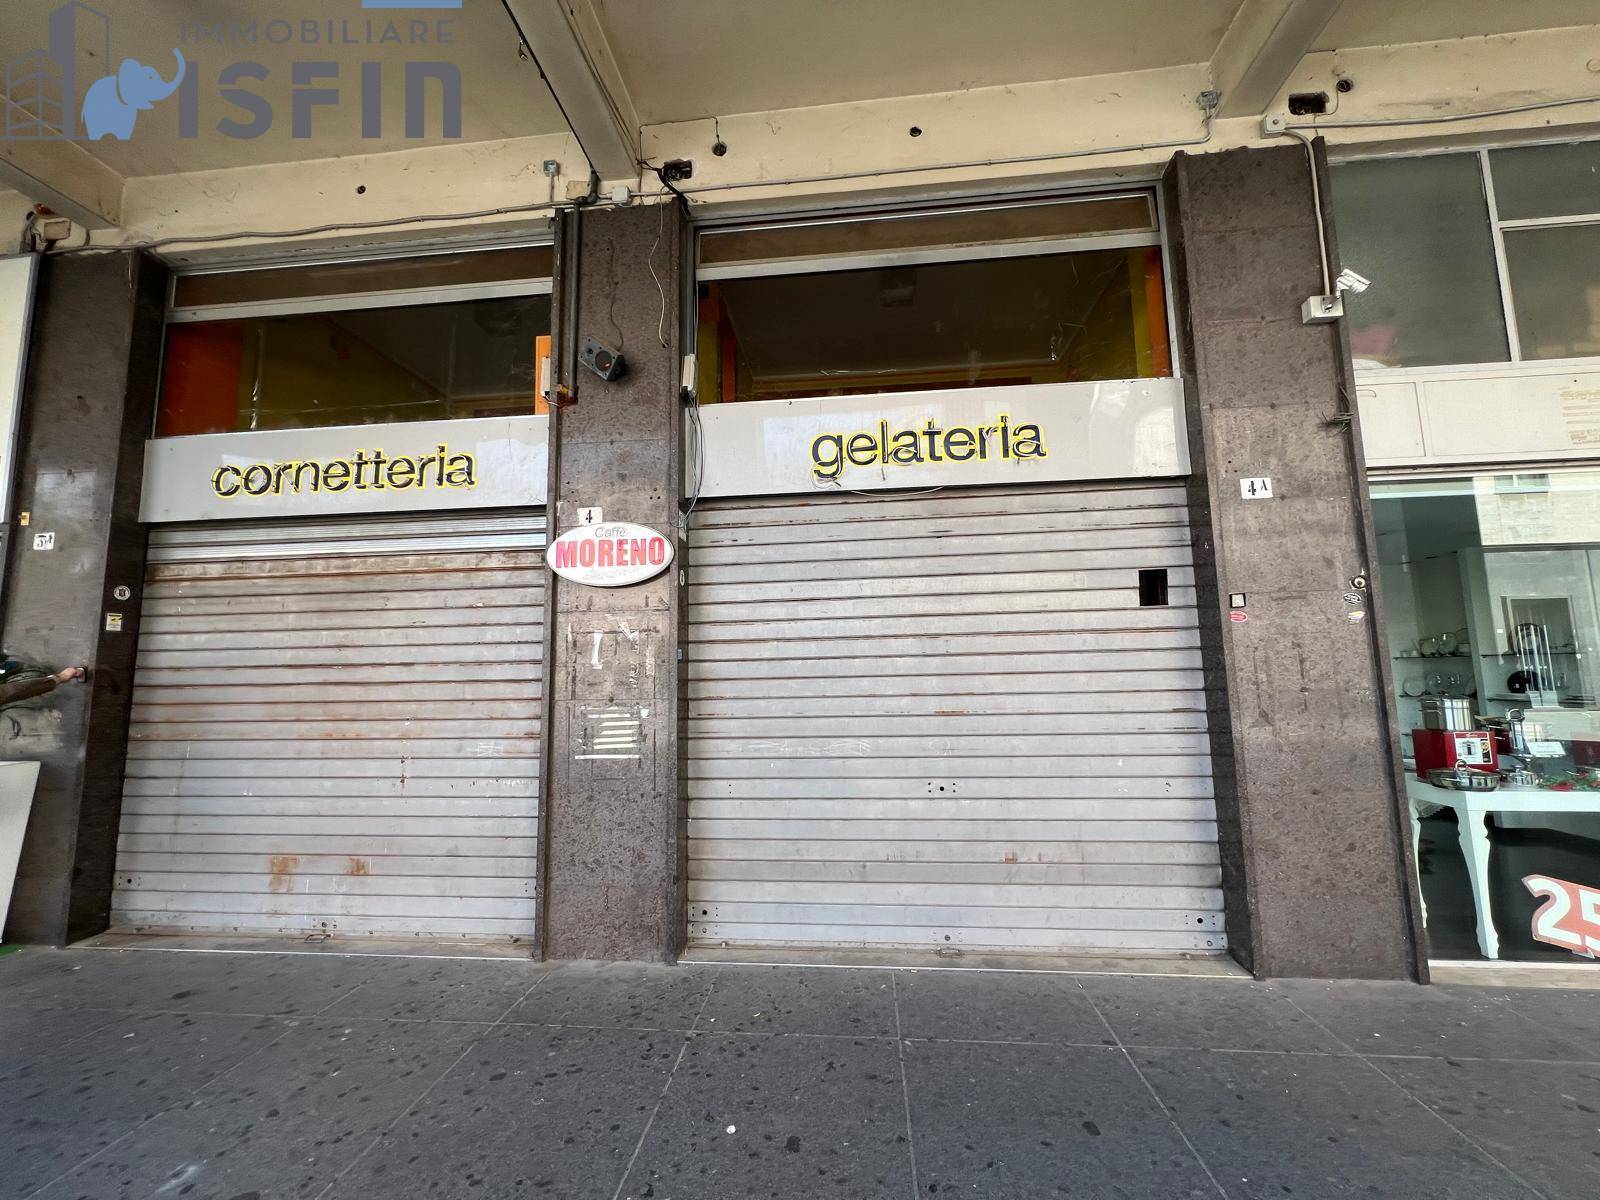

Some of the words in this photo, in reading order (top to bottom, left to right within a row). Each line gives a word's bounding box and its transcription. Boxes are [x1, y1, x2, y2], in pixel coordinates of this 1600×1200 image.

[210, 443, 477, 497] cornetteria
[811, 414, 1047, 479] gelateria
[556, 536, 665, 568] MORENO
